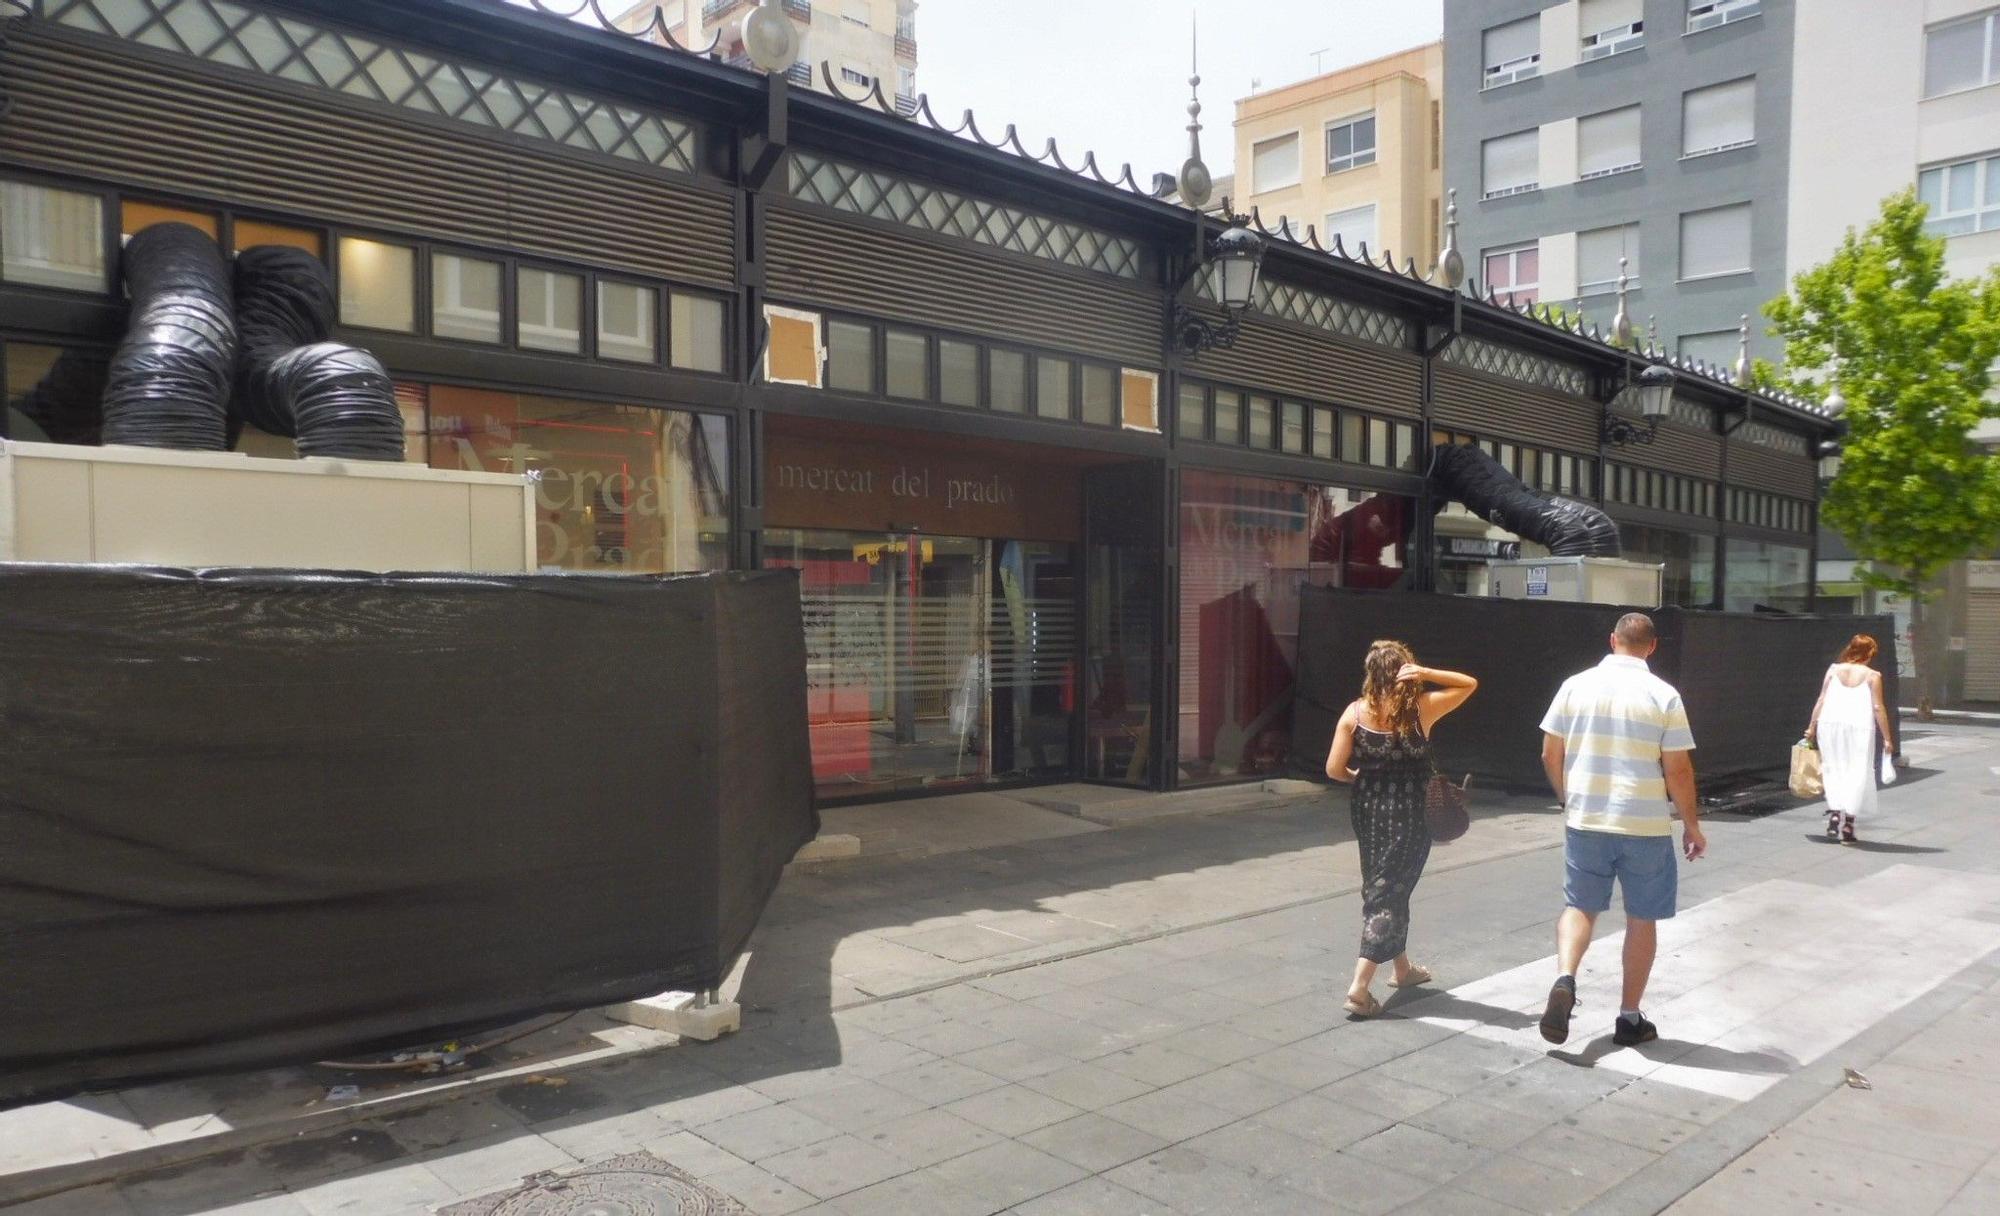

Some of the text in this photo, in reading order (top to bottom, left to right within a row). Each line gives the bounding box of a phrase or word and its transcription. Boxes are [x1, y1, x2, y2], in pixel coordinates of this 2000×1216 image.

[777, 463, 1016, 509] mercat del prado
